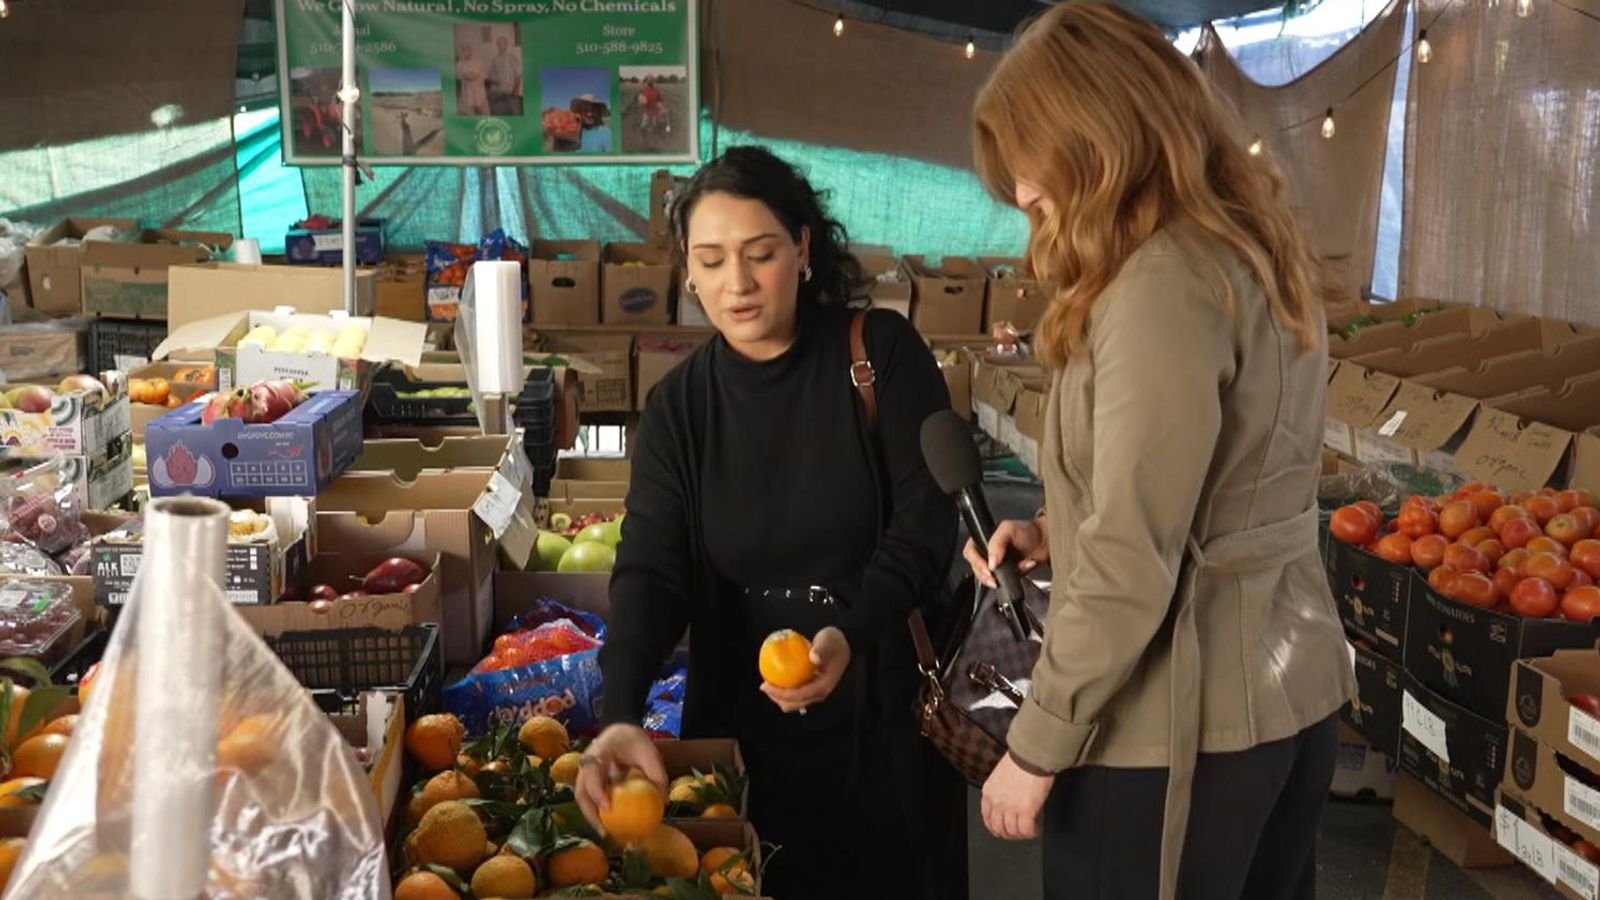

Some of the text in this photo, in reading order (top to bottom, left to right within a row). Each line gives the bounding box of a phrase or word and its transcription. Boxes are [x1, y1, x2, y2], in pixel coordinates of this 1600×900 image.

[297, 0, 325, 12] We
[327, 0, 378, 12] Gow
[463, 1, 489, 12] No
[491, 1, 549, 13] Spray,
[553, 1, 577, 12] No
[580, 0, 676, 12] Chemicals
[602, 24, 636, 36] Store
[310, 42, 396, 54] 510-7-2586
[575, 41, 663, 55] 510-588-9825
